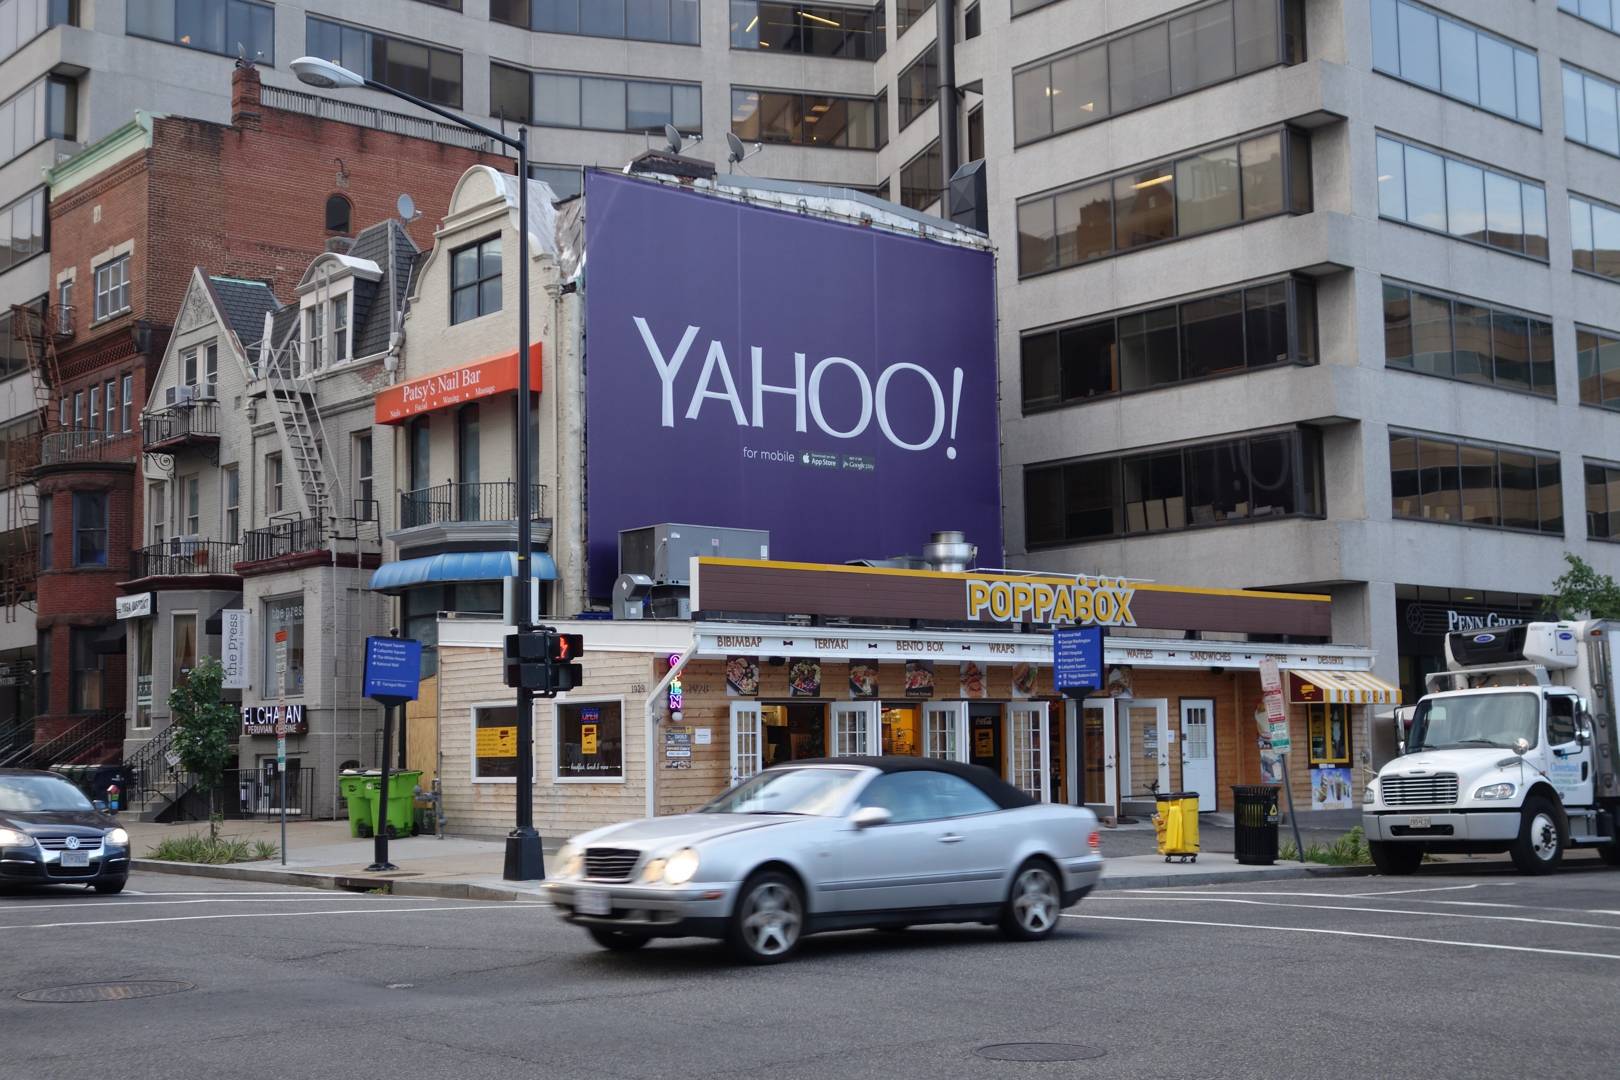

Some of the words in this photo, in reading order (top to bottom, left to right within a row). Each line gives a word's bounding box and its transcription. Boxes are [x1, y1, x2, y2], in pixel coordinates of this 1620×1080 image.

[403, 380, 436, 403] Patsy's
[438, 372, 459, 394] Nail
[462, 368, 481, 387] Bar
[633, 316, 964, 460] YAHOO!
[743, 446, 758, 459] for
[760, 450, 795, 463] mobile
[966, 579, 1137, 627] POPPABOX
[228, 613, 238, 651] press
[1447, 610, 1484, 632] PENN
[717, 636, 762, 648] BIBIMBAP
[814, 638, 849, 650] TERIYAKI
[896, 640, 924, 651] BENTO
[926, 641, 944, 652] BOX
[988, 643, 1016, 654] WRAPS
[1126, 648, 1153, 659] WAFFLES
[1190, 651, 1232, 662] SANDWICHES
[1317, 655, 1344, 665] DESSERTS
[226, 653, 238, 677] the
[243, 707, 254, 725] EL
[256, 705, 302, 725] CHAAN
[247, 725, 273, 734] PERUVIAN
